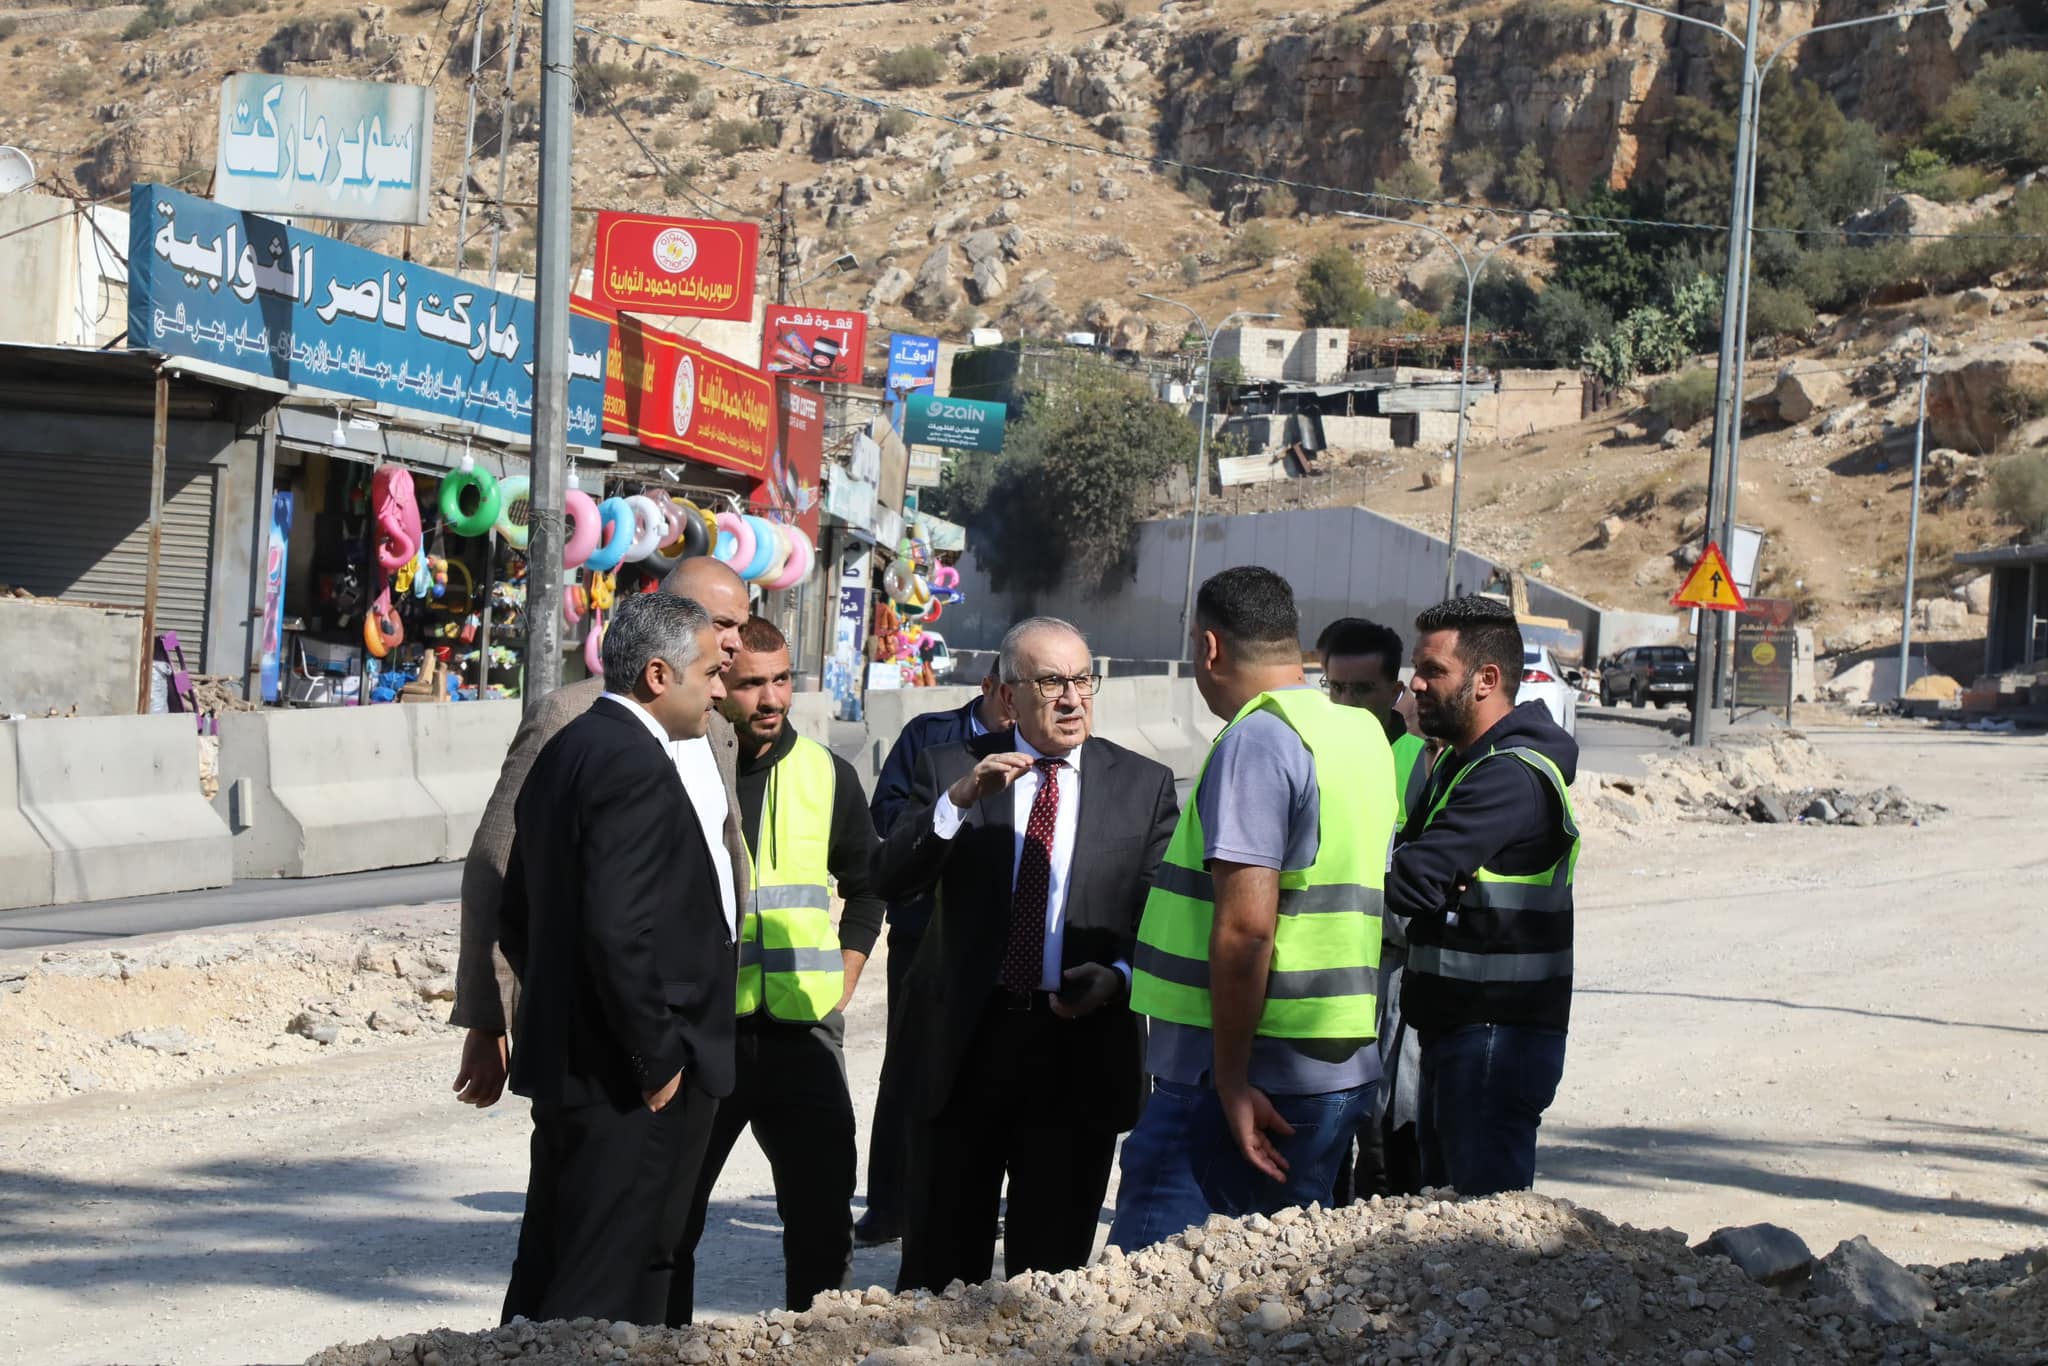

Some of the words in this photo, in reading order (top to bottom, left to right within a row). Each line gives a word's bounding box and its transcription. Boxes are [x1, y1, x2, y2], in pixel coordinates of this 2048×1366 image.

[154, 200, 314, 307] الثوابية
[610, 265, 645, 297] الثوابية
[644, 278, 678, 298] محمود
[315, 269, 407, 331] ناصر
[416, 293, 521, 364] ماركت
[775, 312, 813, 327] شهم
[814, 315, 853, 331] قهوة
[895, 347, 935, 365] الوفاء
